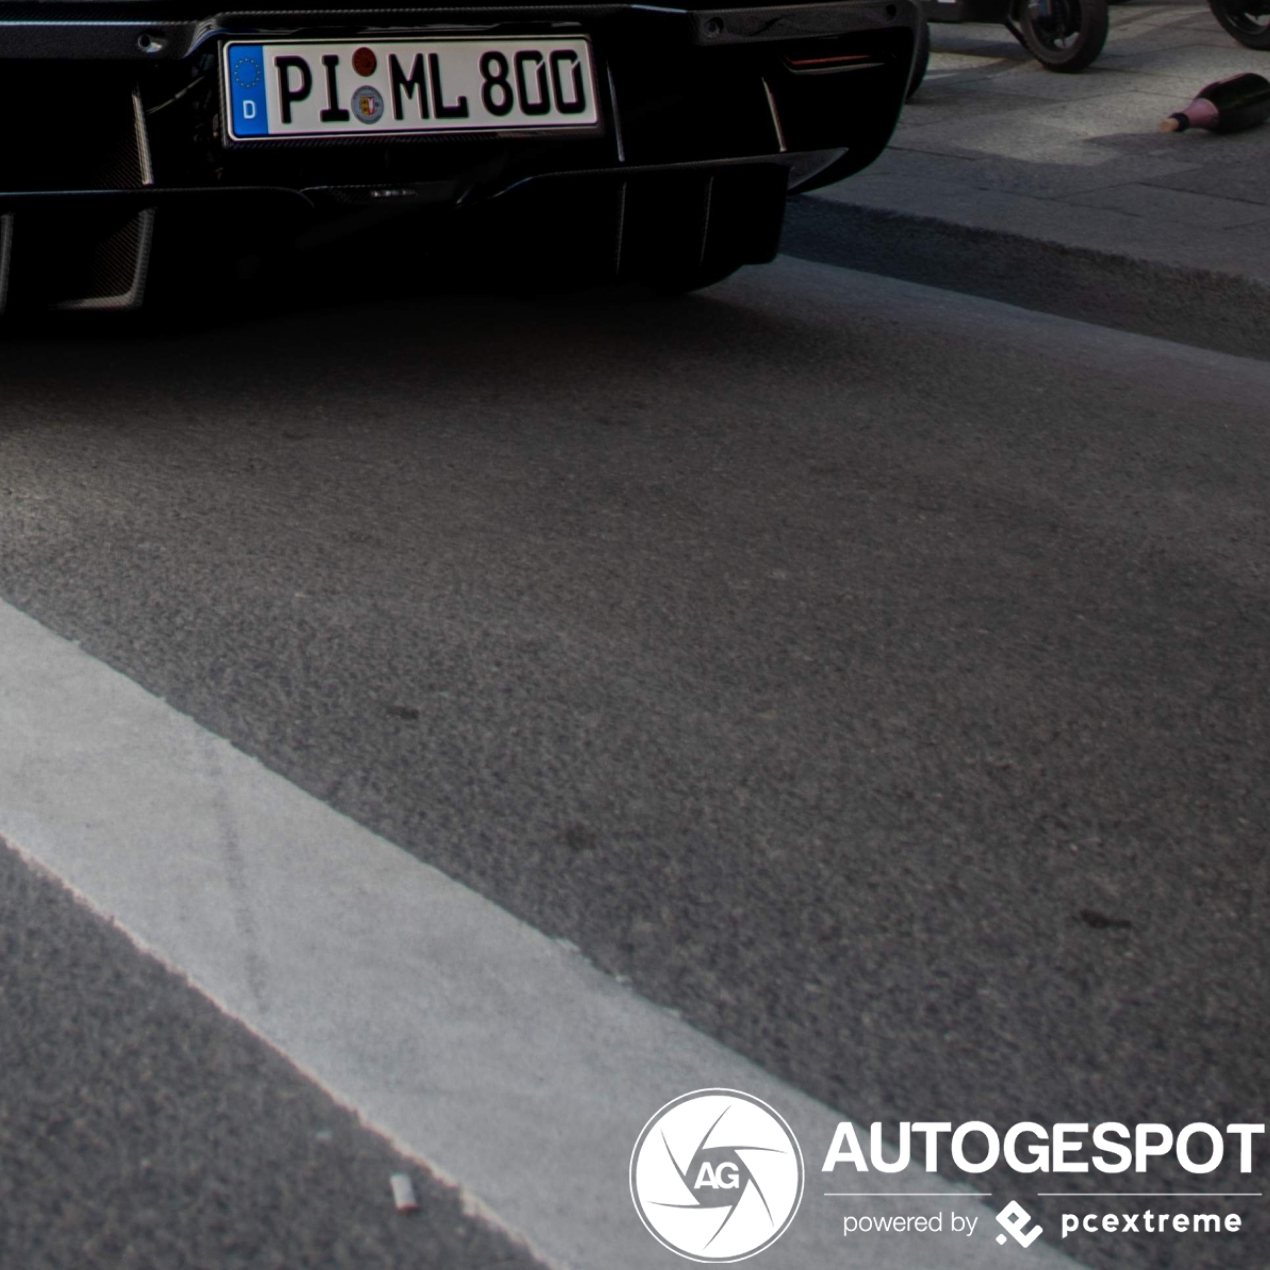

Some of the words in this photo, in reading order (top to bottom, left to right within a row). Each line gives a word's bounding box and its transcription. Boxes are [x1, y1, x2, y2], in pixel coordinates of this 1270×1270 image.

[242, 100, 257, 120] D
[274, 54, 350, 125] PI
[387, 52, 470, 121] ML
[479, 49, 587, 117] 800
